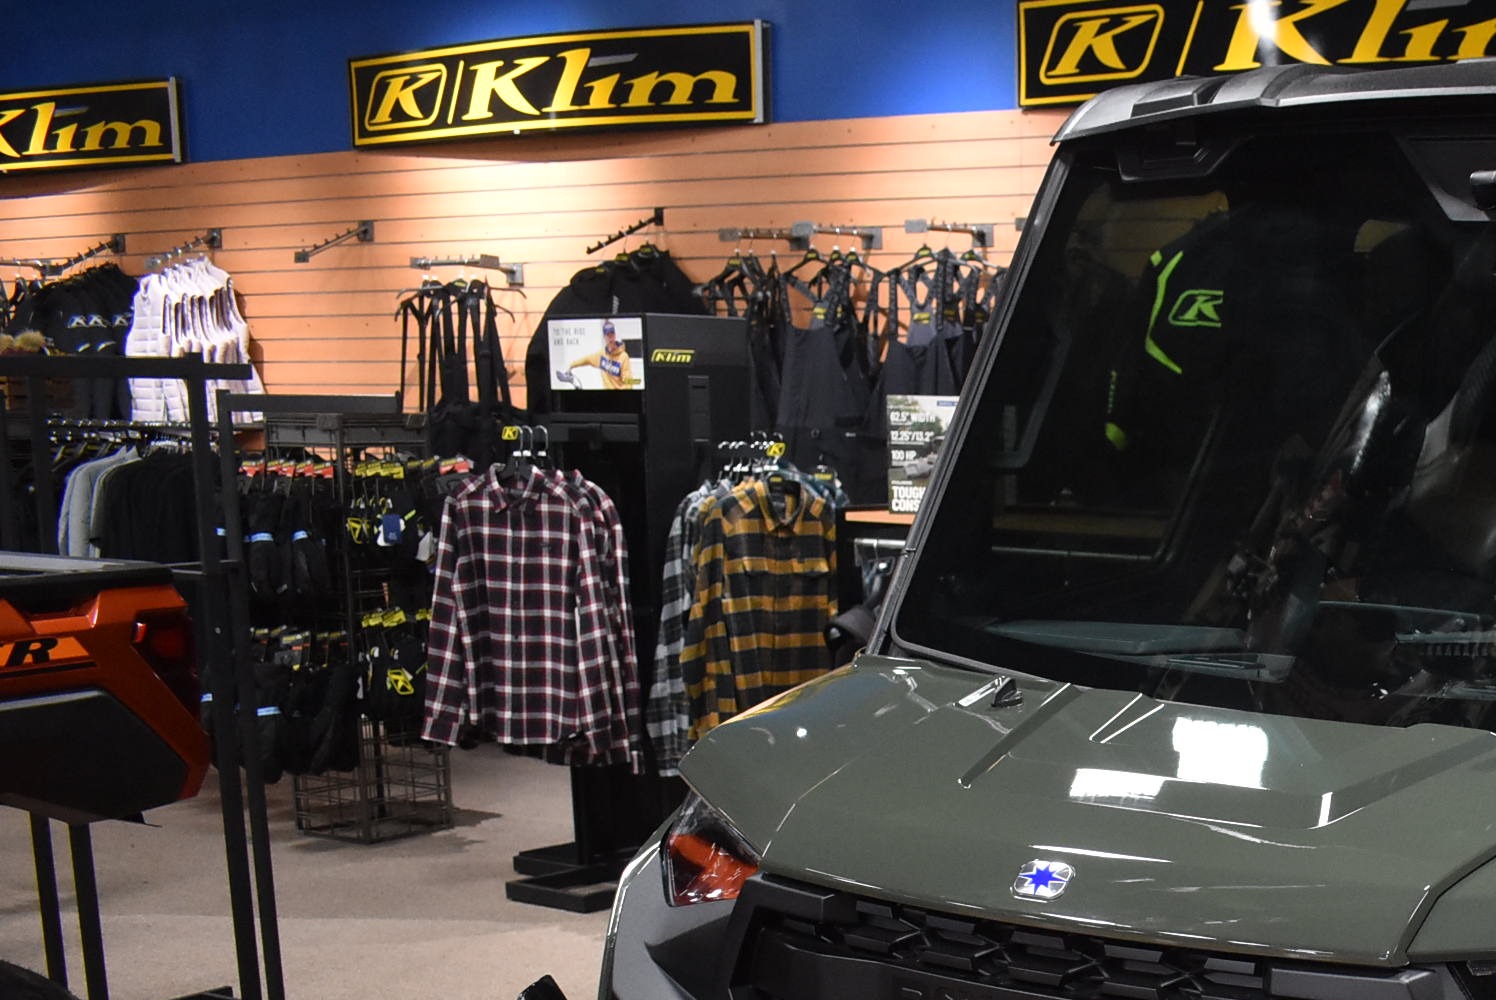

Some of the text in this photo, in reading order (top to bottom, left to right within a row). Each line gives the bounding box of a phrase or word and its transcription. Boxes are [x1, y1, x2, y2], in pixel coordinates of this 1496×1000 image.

[1060, 14, 1154, 75] K
[369, 47, 740, 124] K Klim
[655, 350, 693, 364] Klim
